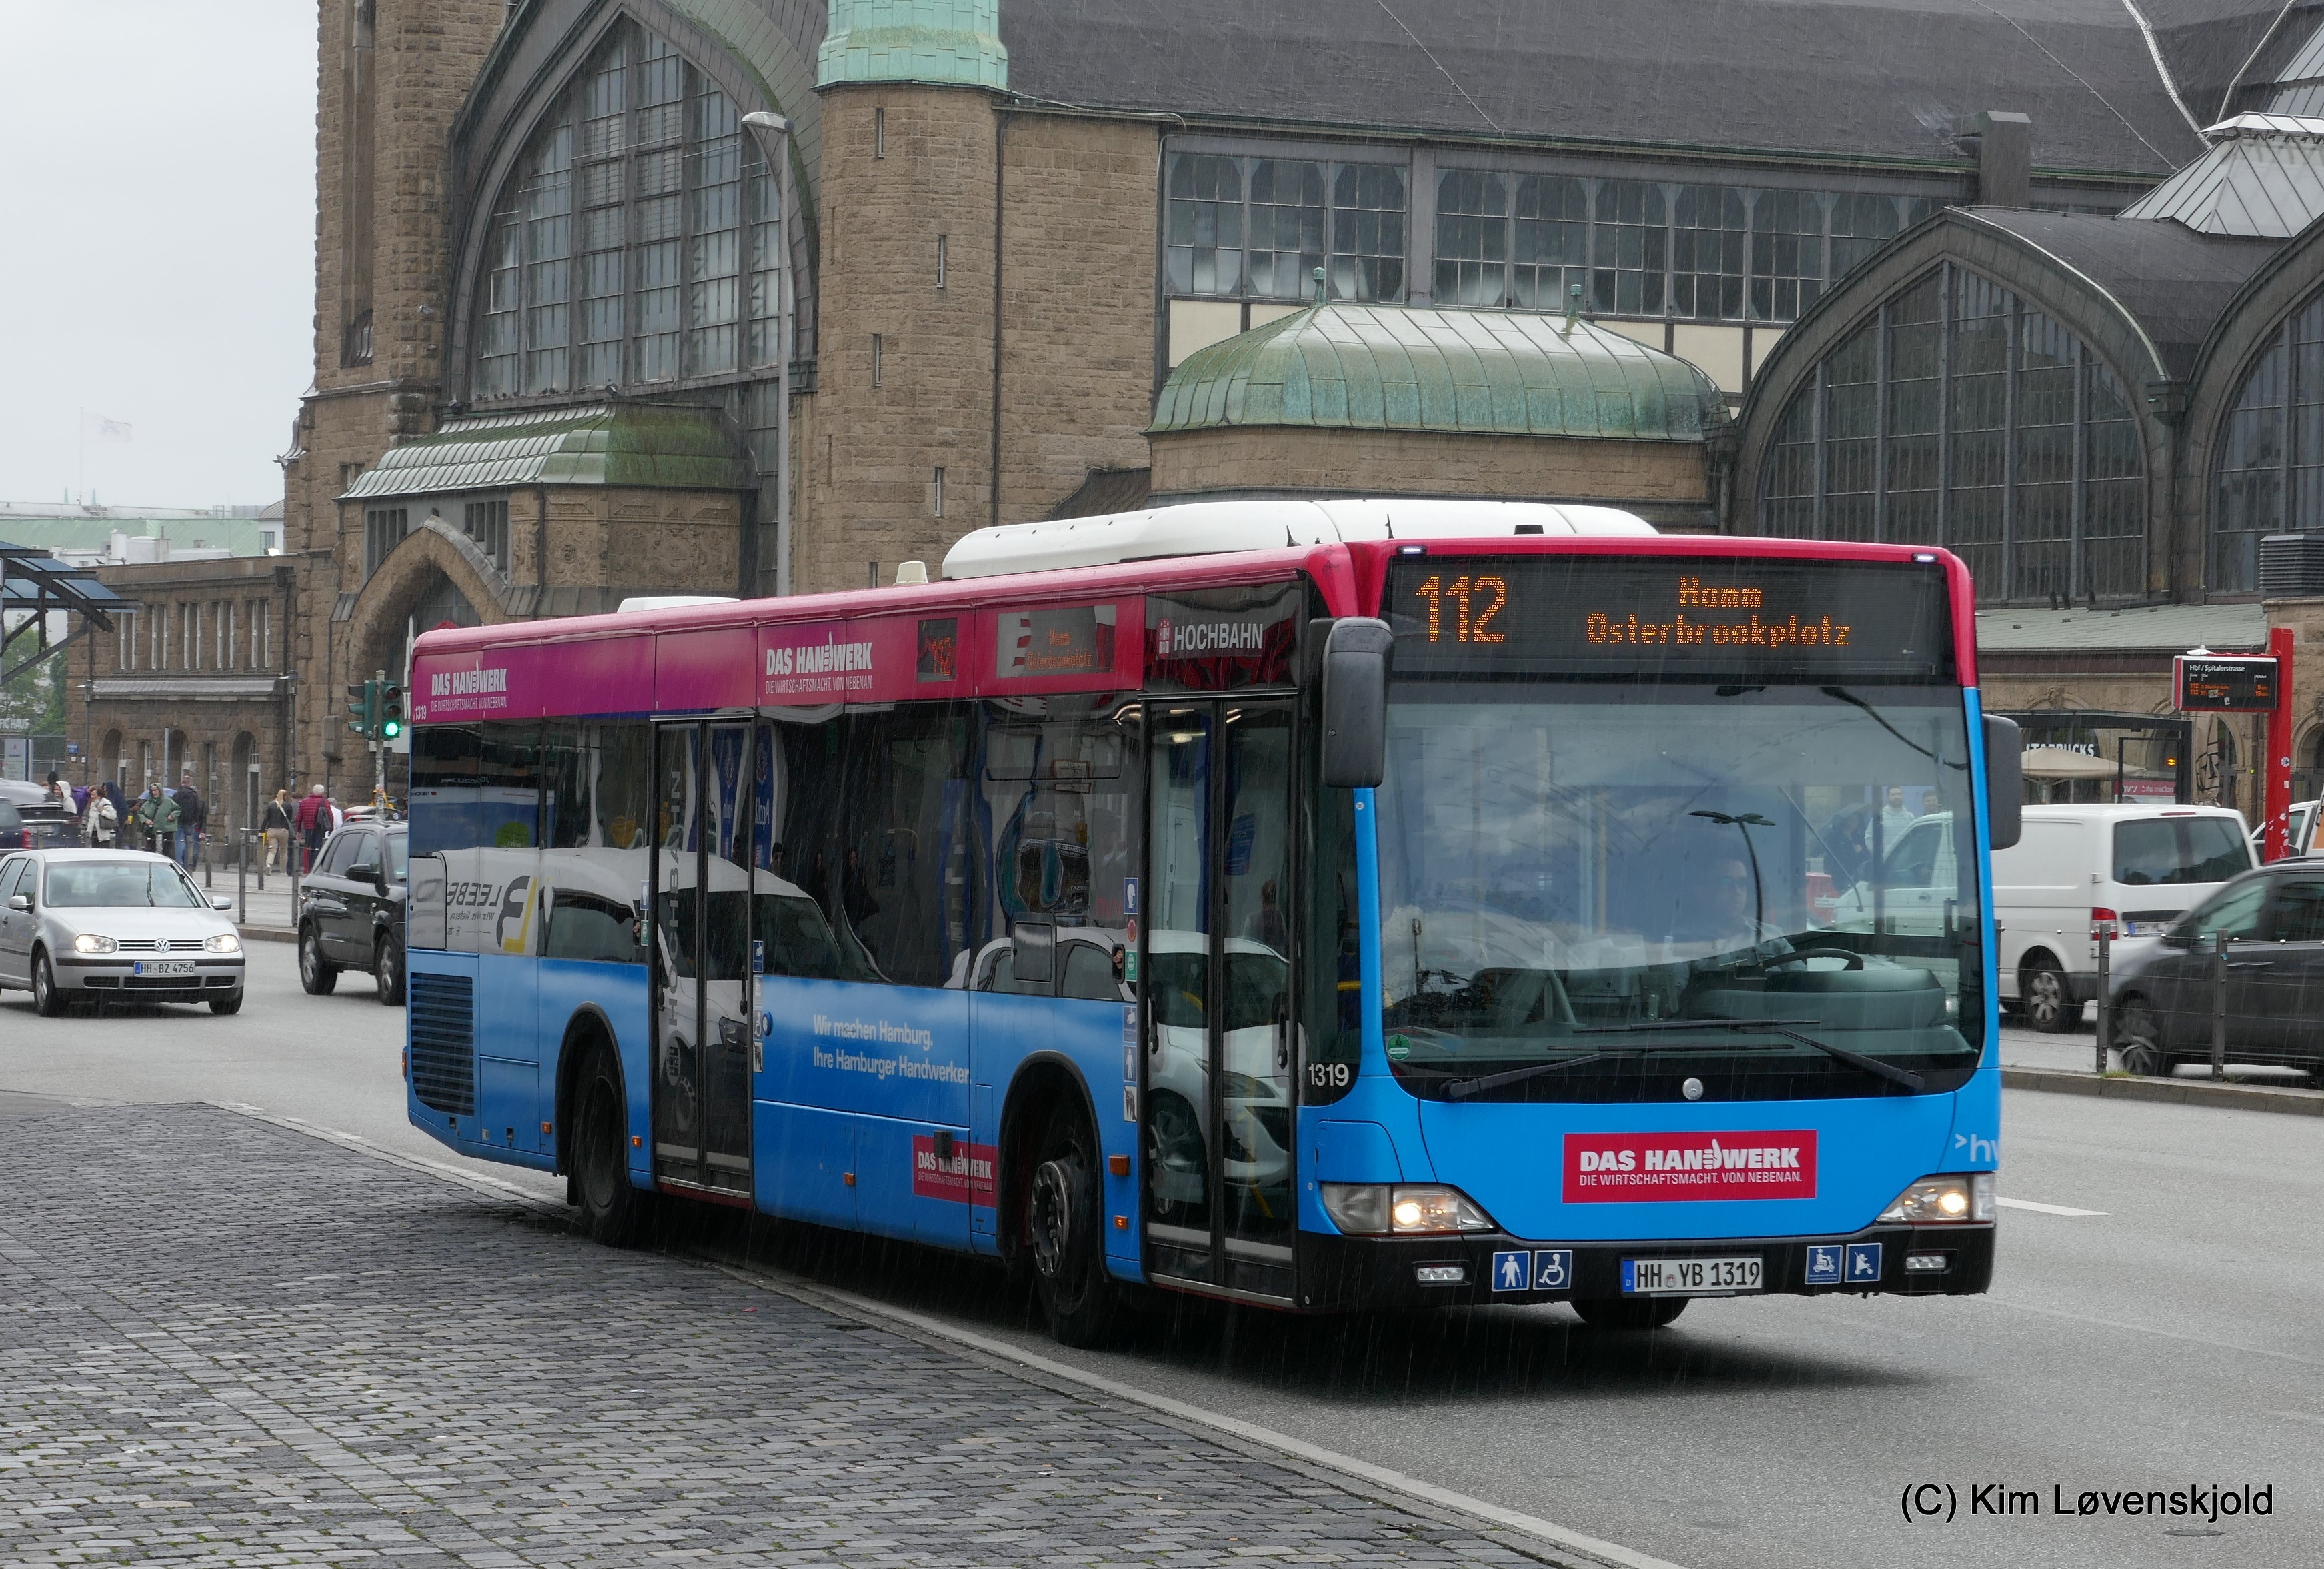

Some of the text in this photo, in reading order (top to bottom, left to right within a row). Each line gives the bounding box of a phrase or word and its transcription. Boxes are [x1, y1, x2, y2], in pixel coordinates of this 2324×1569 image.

[1680, 577, 1762, 608] Hamm
[1416, 577, 1506, 643] 112
[1174, 623, 1264, 651] HOCHBAHN
[1587, 613, 1851, 647] Osterbrookplatz
[766, 647, 792, 675] DAS
[431, 673, 450, 696] DAS
[766, 675, 873, 694] DIE WIRTSCHAFTSMACHT. VON NEBENAN.
[415, 705, 427, 721] 1319
[668, 771, 682, 1026] HOCHBAHN
[141, 963, 194, 974] HH BZ 4756
[813, 1014, 933, 1052] Wir machen Hamburg.
[813, 1046, 972, 1084] Ihre Hamburger Handwerker.
[1308, 1063, 1349, 1086] 1319
[918, 1151, 936, 1170] DAS
[1580, 1150, 1636, 1172] DAS
[1580, 1171, 1803, 1186] DIE WIRTSCHAFTSMACHT. VON NEBENAN.
[1636, 1260, 1760, 1288] HH YB 1319
